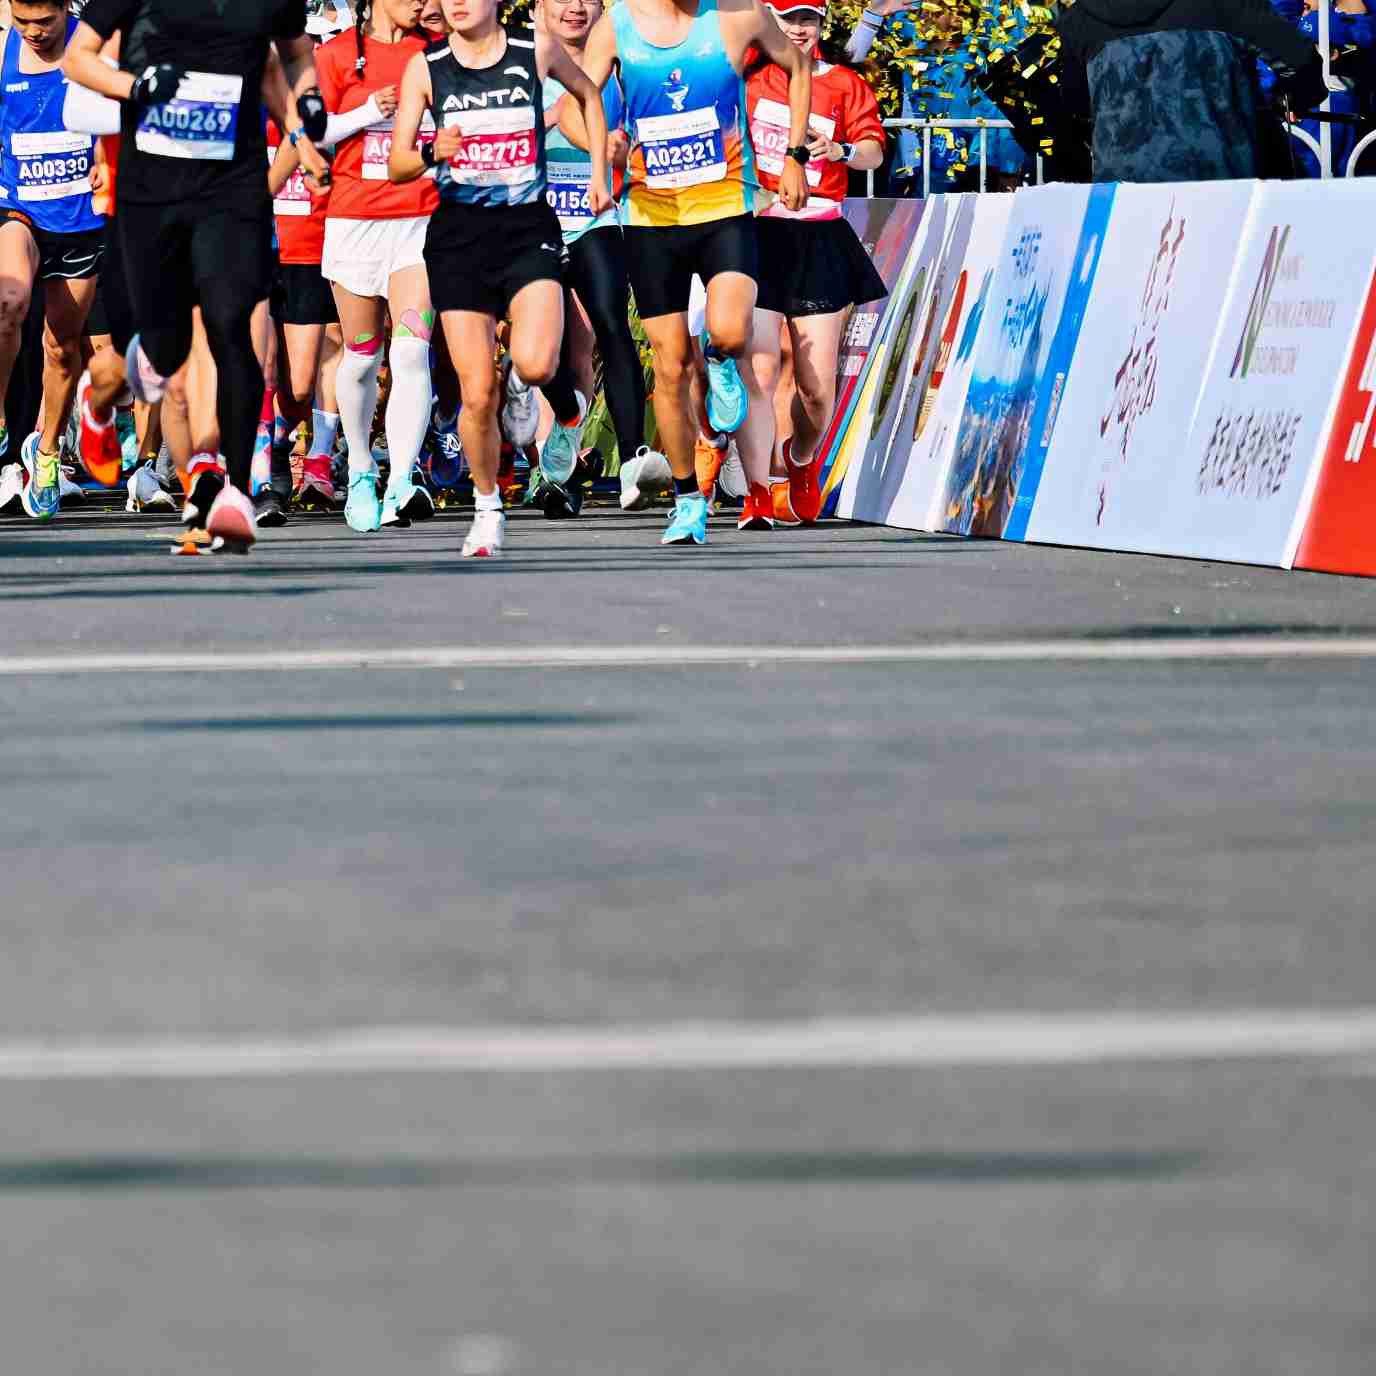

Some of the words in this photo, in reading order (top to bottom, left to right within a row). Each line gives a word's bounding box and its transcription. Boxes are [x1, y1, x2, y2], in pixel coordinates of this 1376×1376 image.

[442, 86, 530, 112] ANTA
[144, 105, 232, 134] A00269
[454, 140, 531, 164] A02773
[646, 143, 715, 170] A02321
[19, 156, 88, 180] A00330
